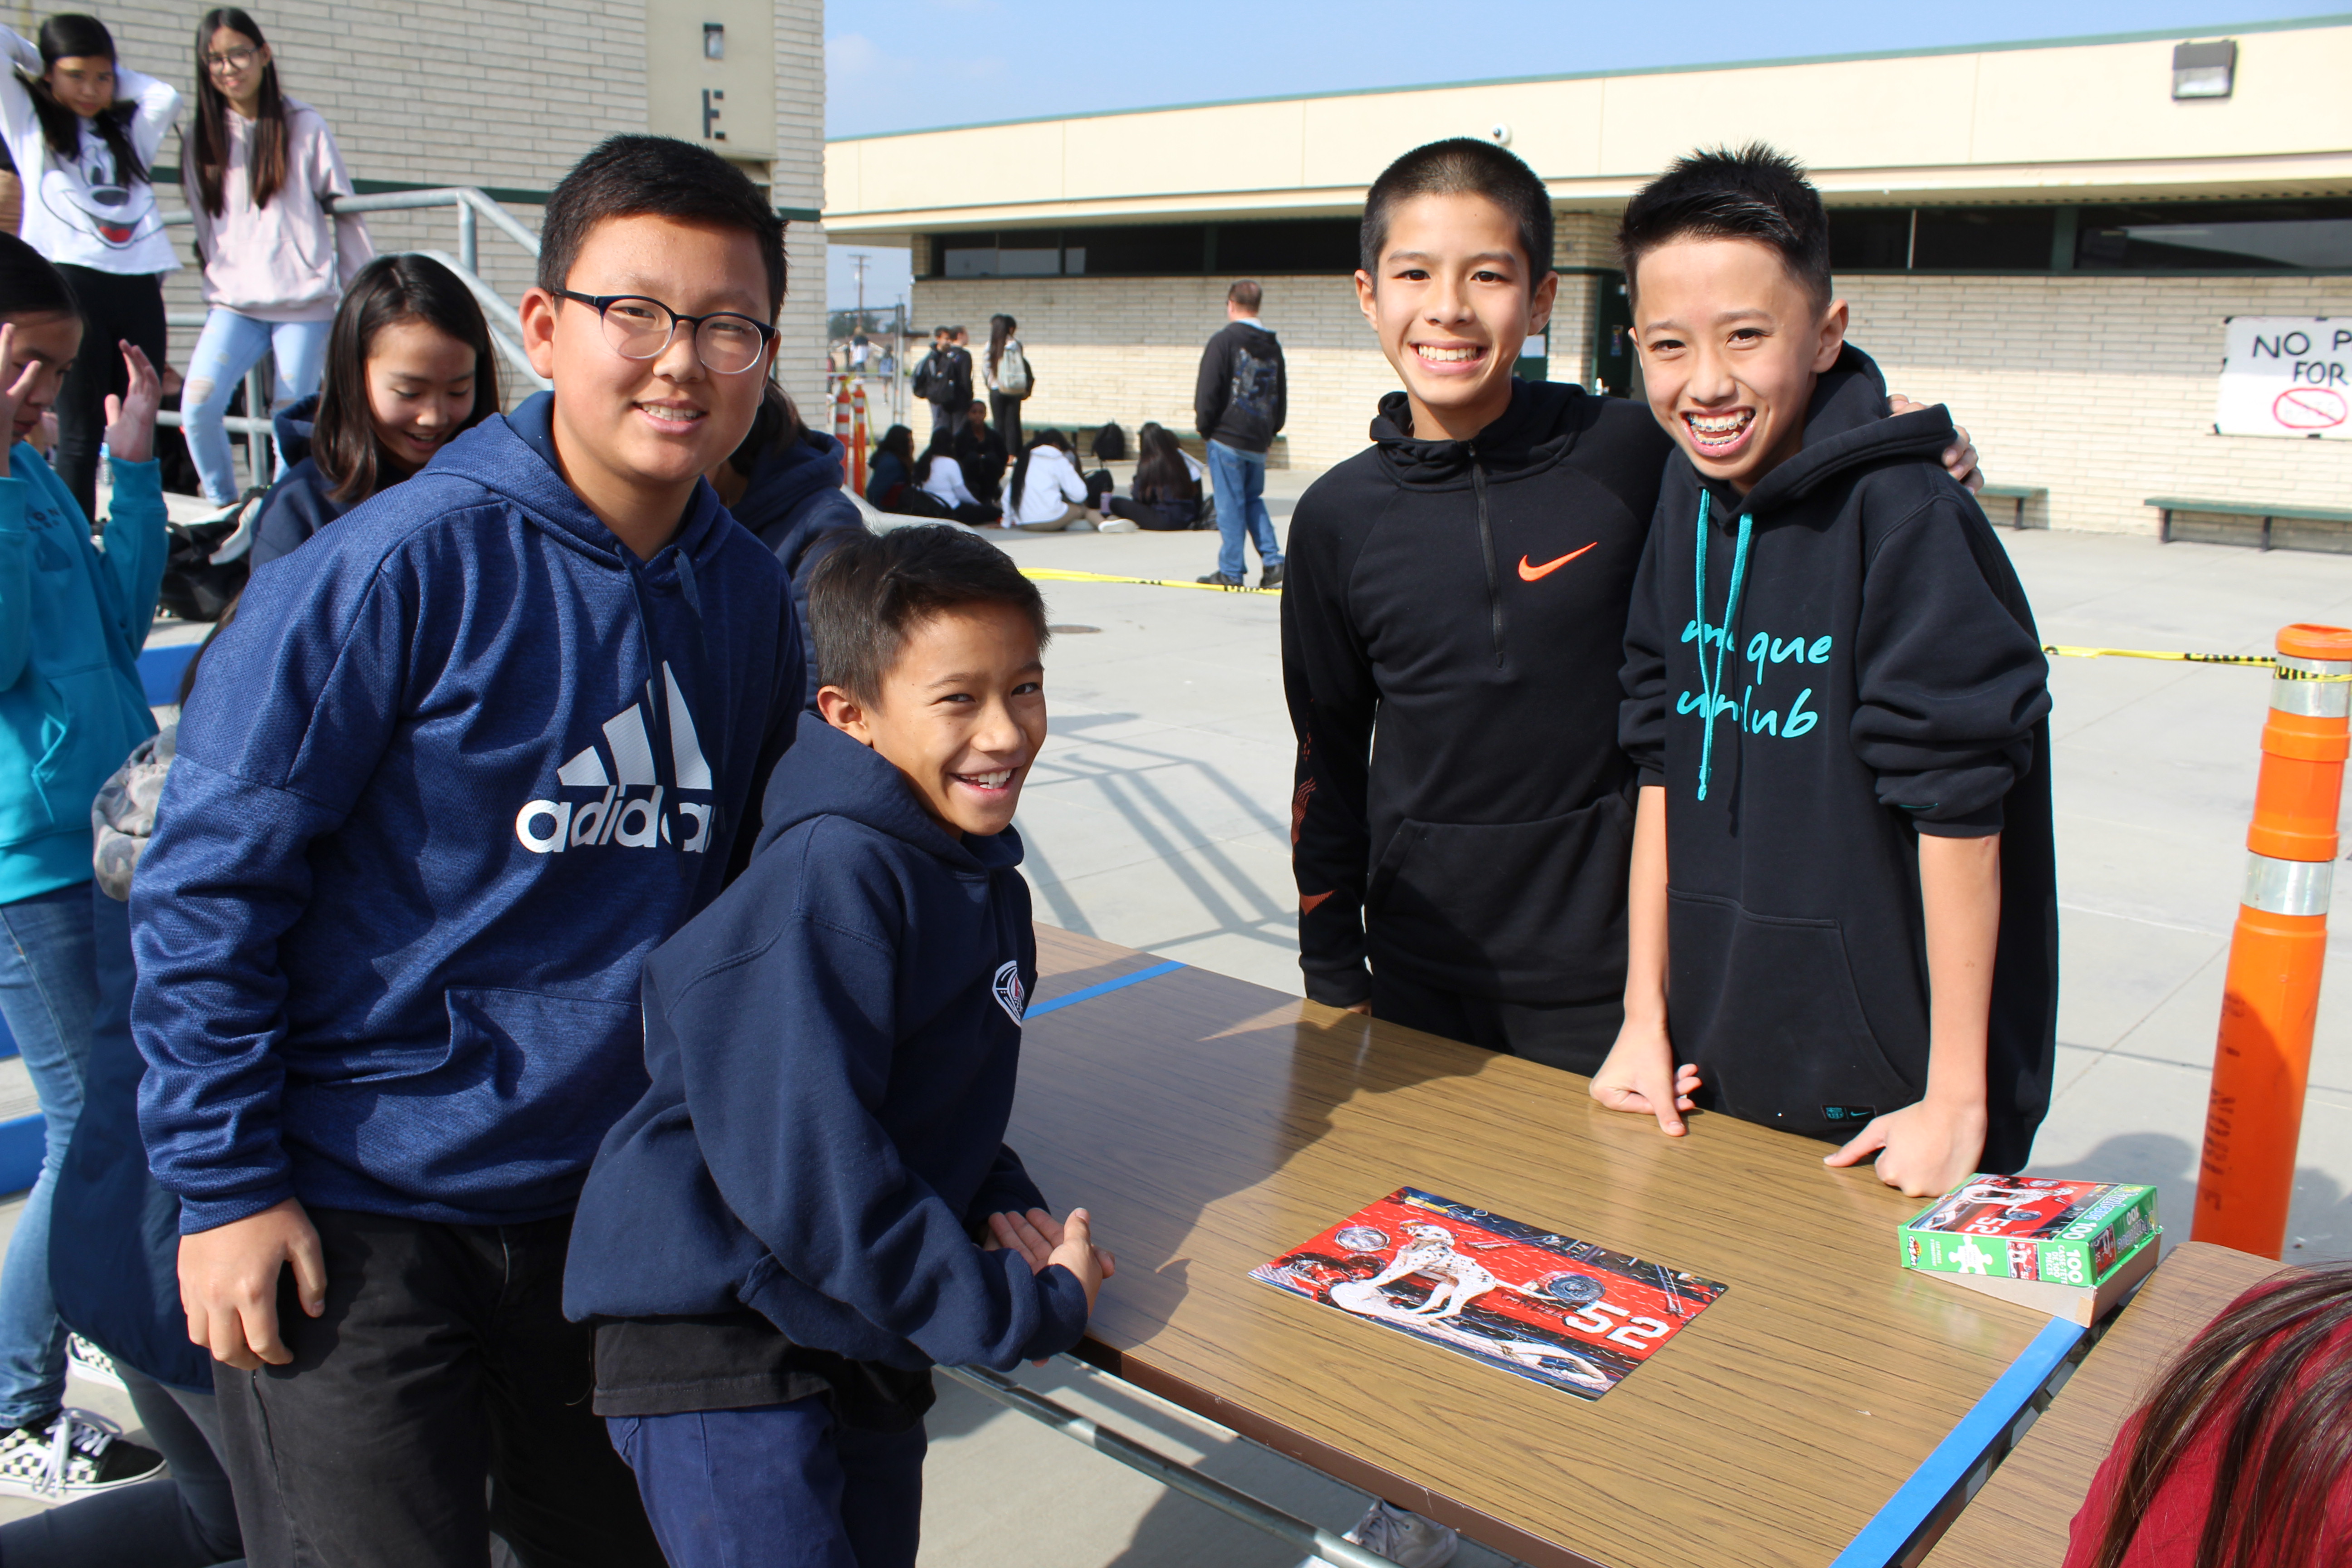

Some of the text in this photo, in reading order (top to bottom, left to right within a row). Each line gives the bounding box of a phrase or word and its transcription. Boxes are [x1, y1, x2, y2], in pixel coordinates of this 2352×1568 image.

[702, 88, 725, 140] E
[2253, 332, 2311, 358] NO
[2293, 361, 2349, 387] FOR
[1747, 631, 1832, 685] que
[1740, 685, 1818, 739] lub
[515, 784, 712, 853] adida
[1965, 1217, 2012, 1234] 52
[2062, 1222, 2097, 1240] 100
[2051, 1251, 2059, 1261] DE
[2066, 1249, 2083, 1284] 100
[1564, 1300, 1670, 1350] 52
